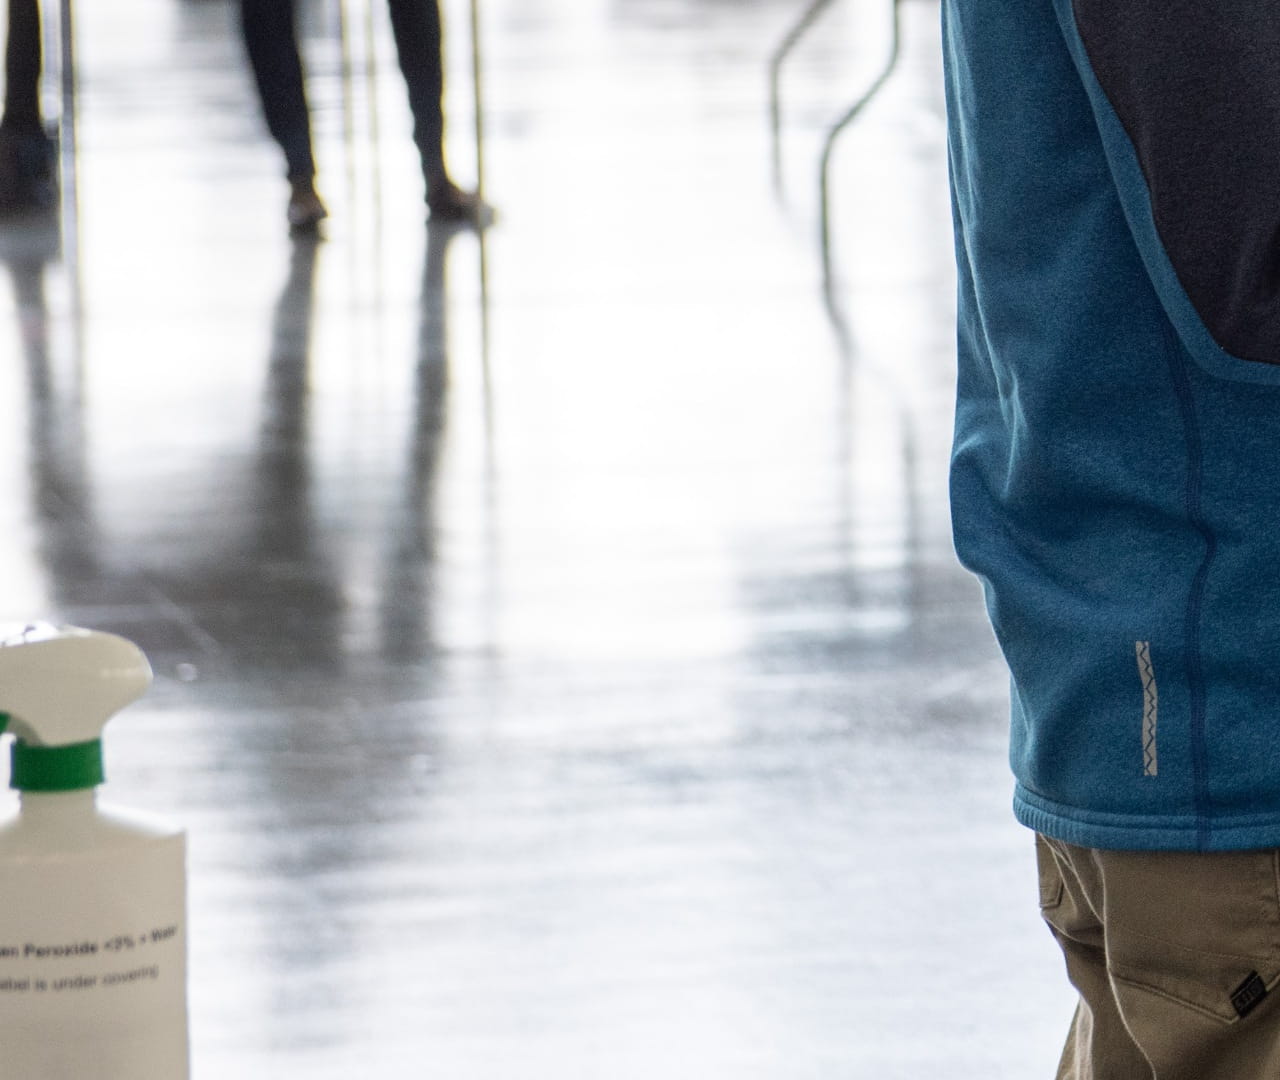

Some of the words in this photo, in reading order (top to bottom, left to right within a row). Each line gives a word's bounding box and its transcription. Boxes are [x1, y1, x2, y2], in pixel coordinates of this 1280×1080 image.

[24, 942, 98, 958] Peroxide
[36, 979, 47, 991] is
[54, 975, 96, 991] under
[103, 964, 159, 985] covering
